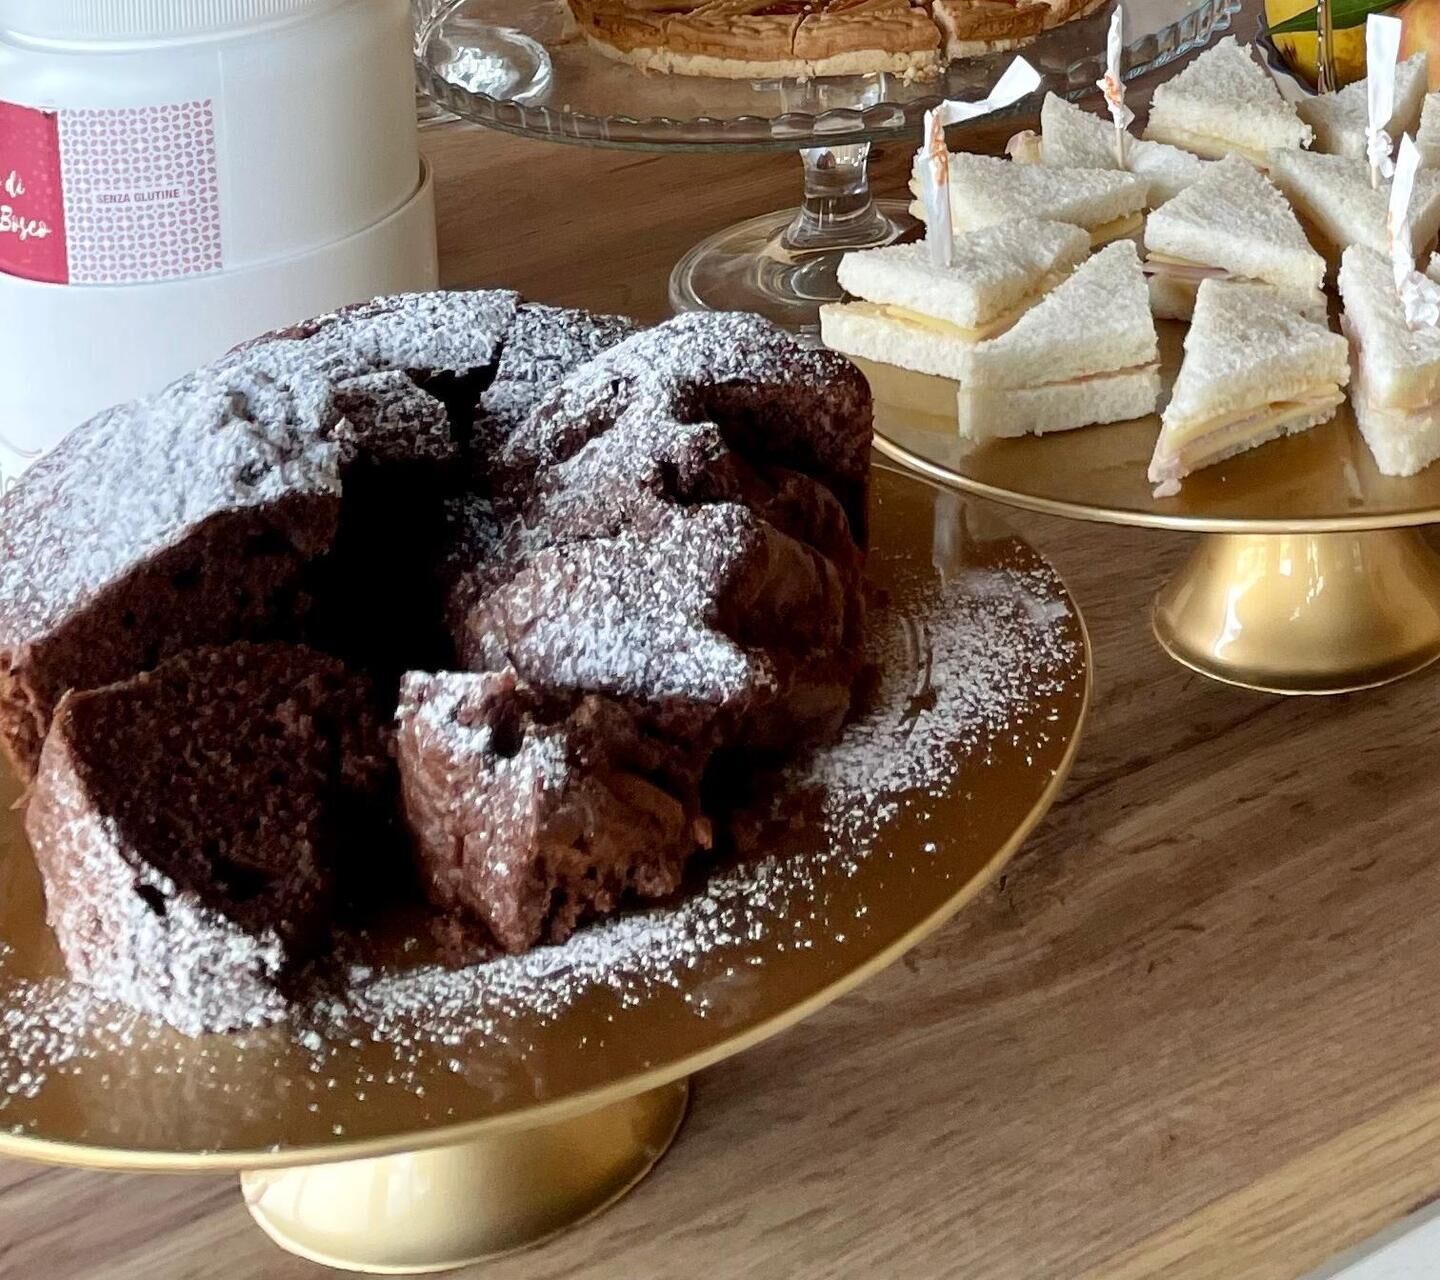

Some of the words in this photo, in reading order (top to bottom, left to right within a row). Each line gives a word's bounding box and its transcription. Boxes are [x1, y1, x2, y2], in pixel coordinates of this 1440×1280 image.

[5, 170, 25, 198] di
[96, 193, 130, 204] SENZA
[133, 188, 180, 202] GLUTINE
[0, 205, 52, 240] Bosco
